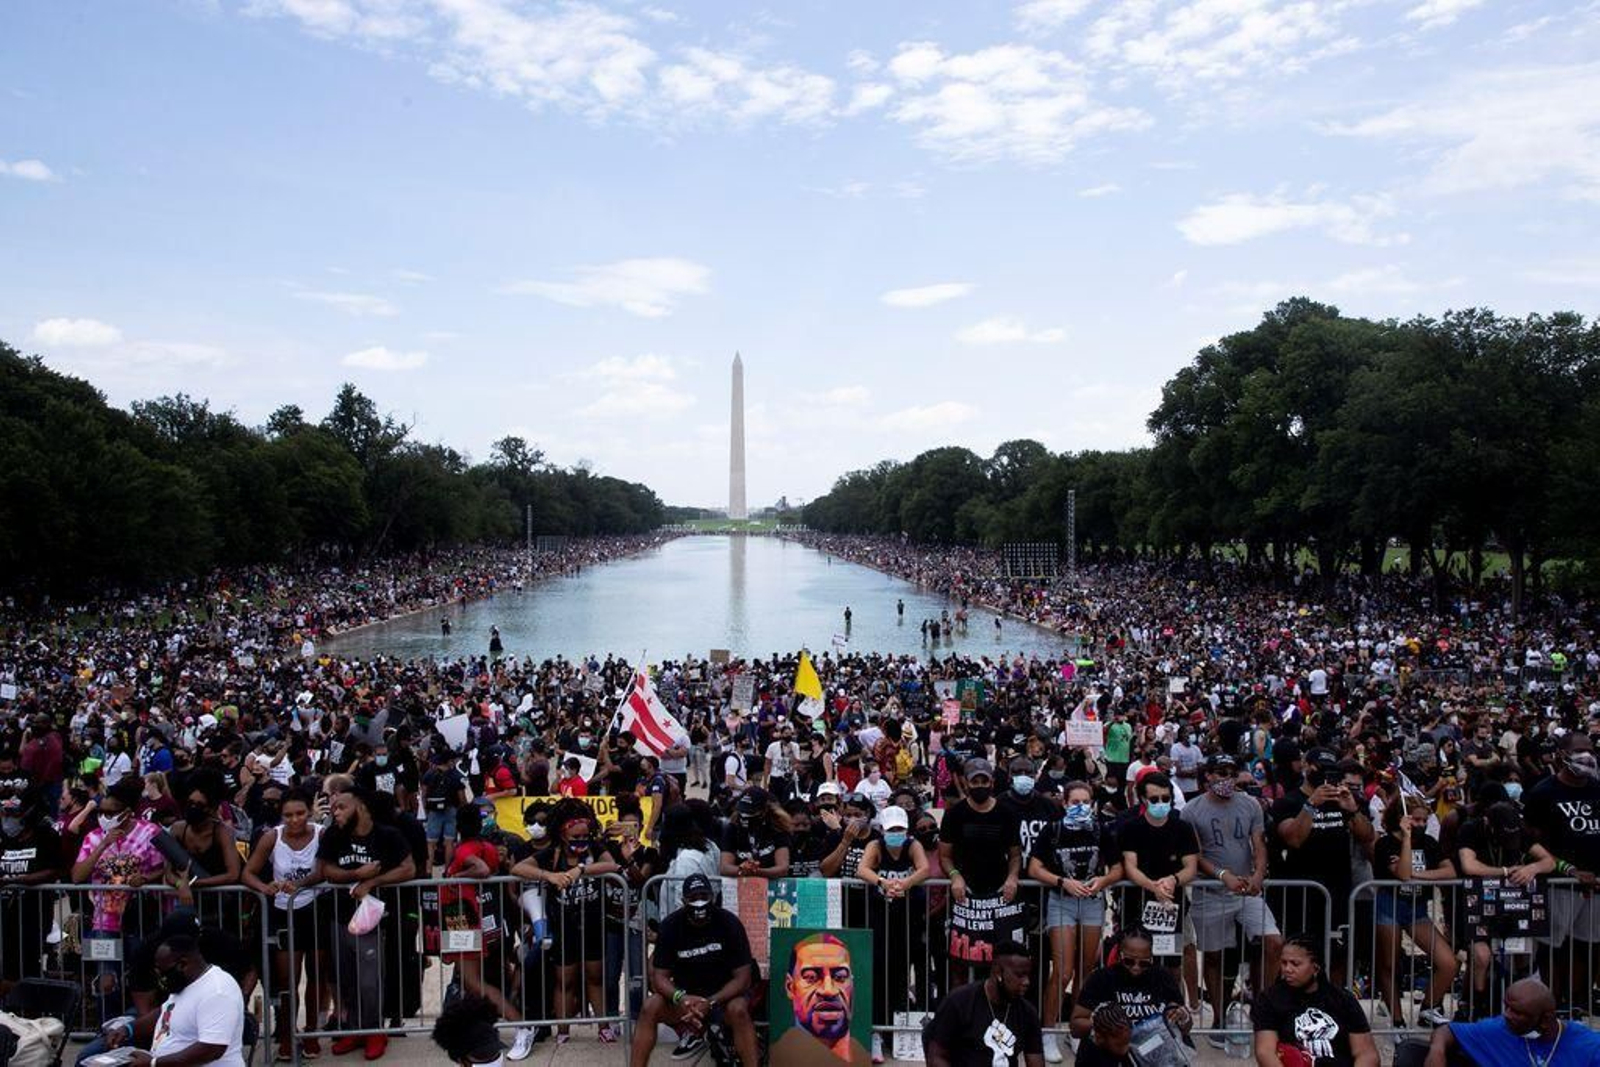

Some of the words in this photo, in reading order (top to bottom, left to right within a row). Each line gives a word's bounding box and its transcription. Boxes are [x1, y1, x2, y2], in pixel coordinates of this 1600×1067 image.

[1556, 800, 1592, 817] We
[1570, 816, 1600, 831] Ou
[1500, 890, 1522, 898] MANY
[1504, 902, 1530, 911] MORE?
[968, 920, 995, 931] LEWIS
